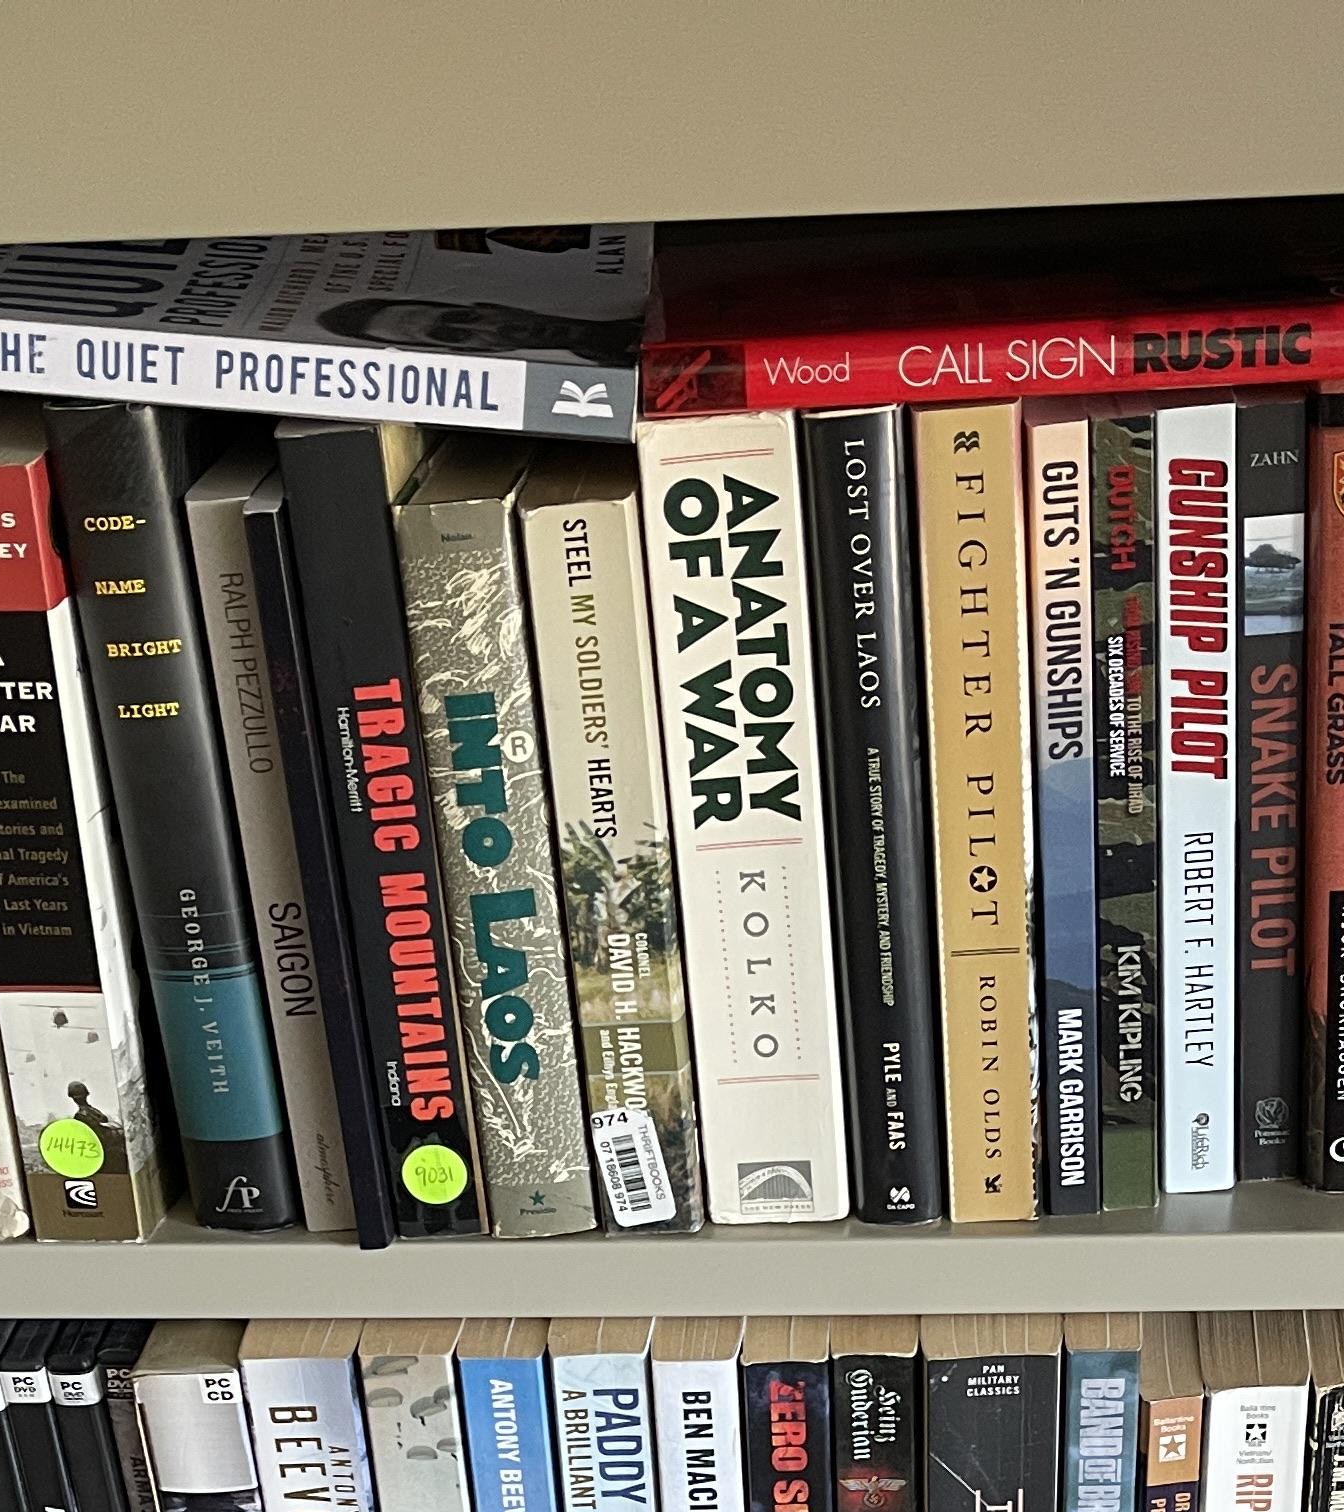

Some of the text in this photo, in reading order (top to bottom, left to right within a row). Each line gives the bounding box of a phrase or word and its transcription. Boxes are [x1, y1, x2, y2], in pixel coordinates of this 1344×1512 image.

[76, 338, 185, 386] QUIET
[214, 348, 500, 412] PROFESSIONAL
[764, 352, 851, 385] Wood
[898, 322, 1313, 388] CALL SIGN RUSTIC
[1250, 450, 1300, 468] ZAHN
[84, 515, 147, 534] CODE-
[95, 578, 146, 596] NAME
[1168, 458, 1229, 780] GUNSHIP PILOT
[107, 640, 182, 658] BRIGHT
[662, 476, 744, 831] OF A WAR
[723, 473, 803, 822] ANATOMY
[118, 702, 180, 719] LIGHT
[353, 678, 454, 1123] TRAGIC MOUNTAINS
[738, 870, 780, 1058] KOLKO
[968, 1374, 1020, 1386] MILITARY
[982, 1364, 1005, 1374] PAN
[966, 1384, 1020, 1397] CLASSICS
[682, 1392, 714, 1440] BEN
[592, 1388, 632, 1504] PADDY
